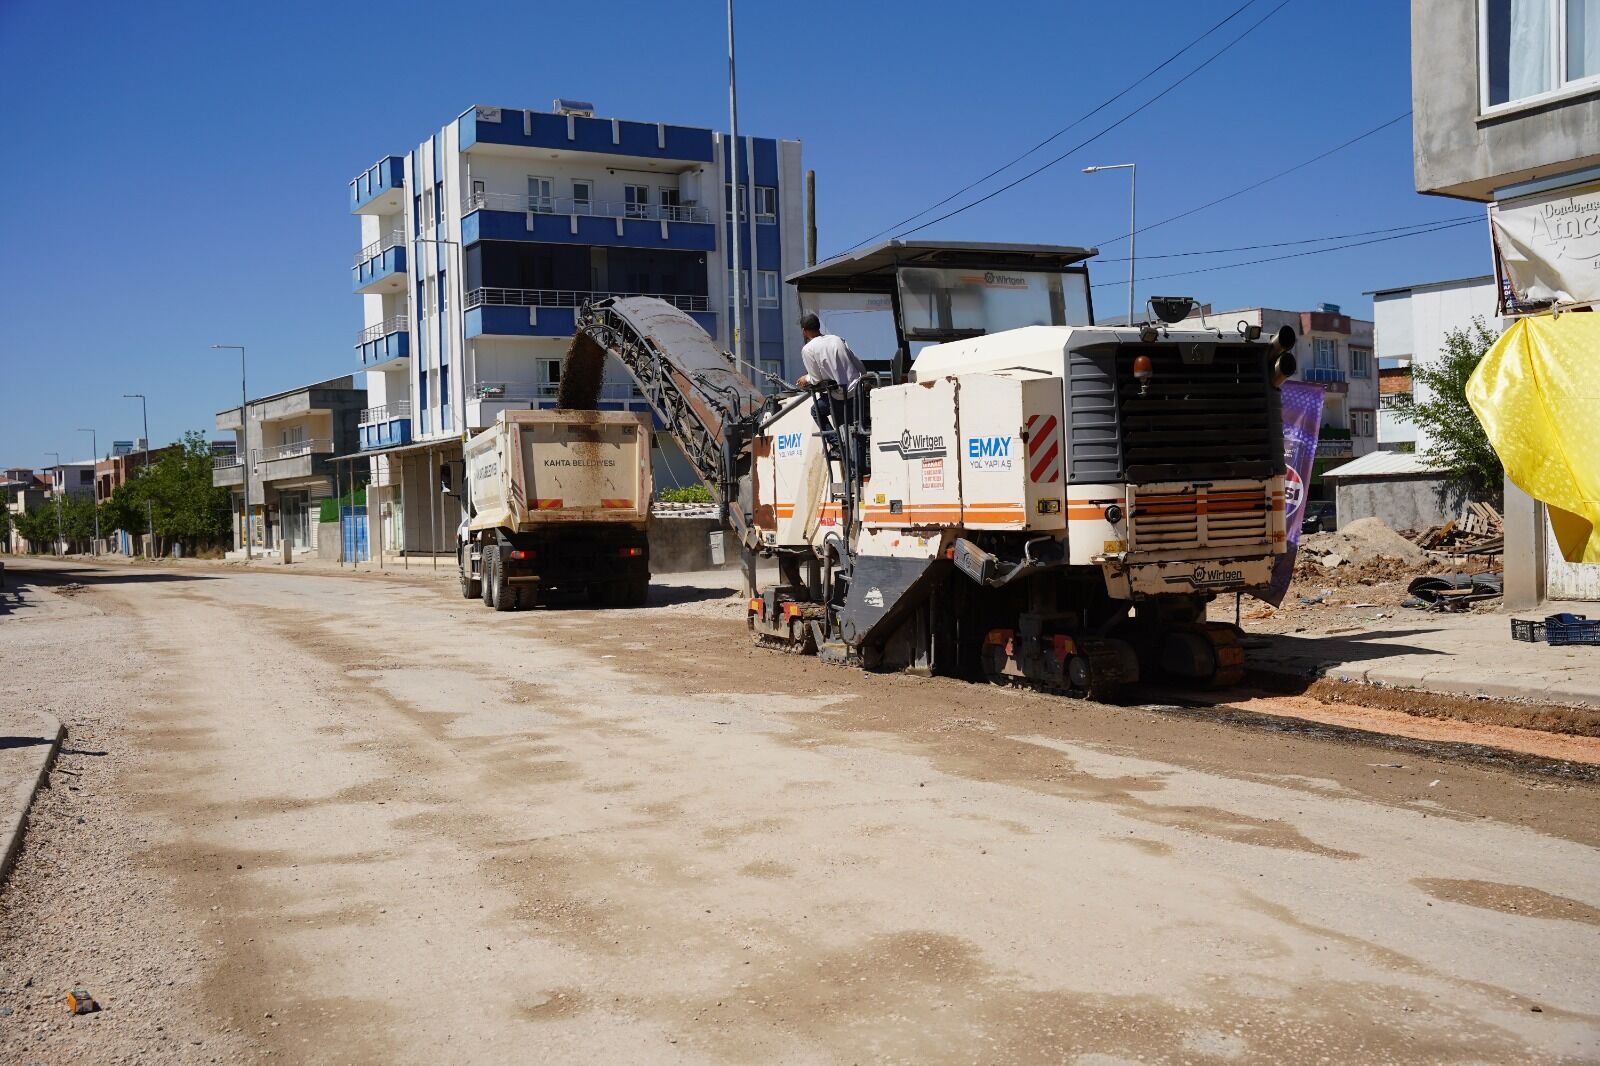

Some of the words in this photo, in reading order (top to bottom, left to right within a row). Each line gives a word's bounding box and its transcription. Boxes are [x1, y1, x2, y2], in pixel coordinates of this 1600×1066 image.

[995, 275, 1025, 285] Wirtgen
[778, 432, 802, 449] EMAY
[912, 435, 944, 450] Wirtgen
[969, 436, 1011, 457] EMAY
[544, 459, 571, 467] KAHTA
[970, 460, 983, 469] YOL
[1208, 569, 1242, 581] Wirtgen
